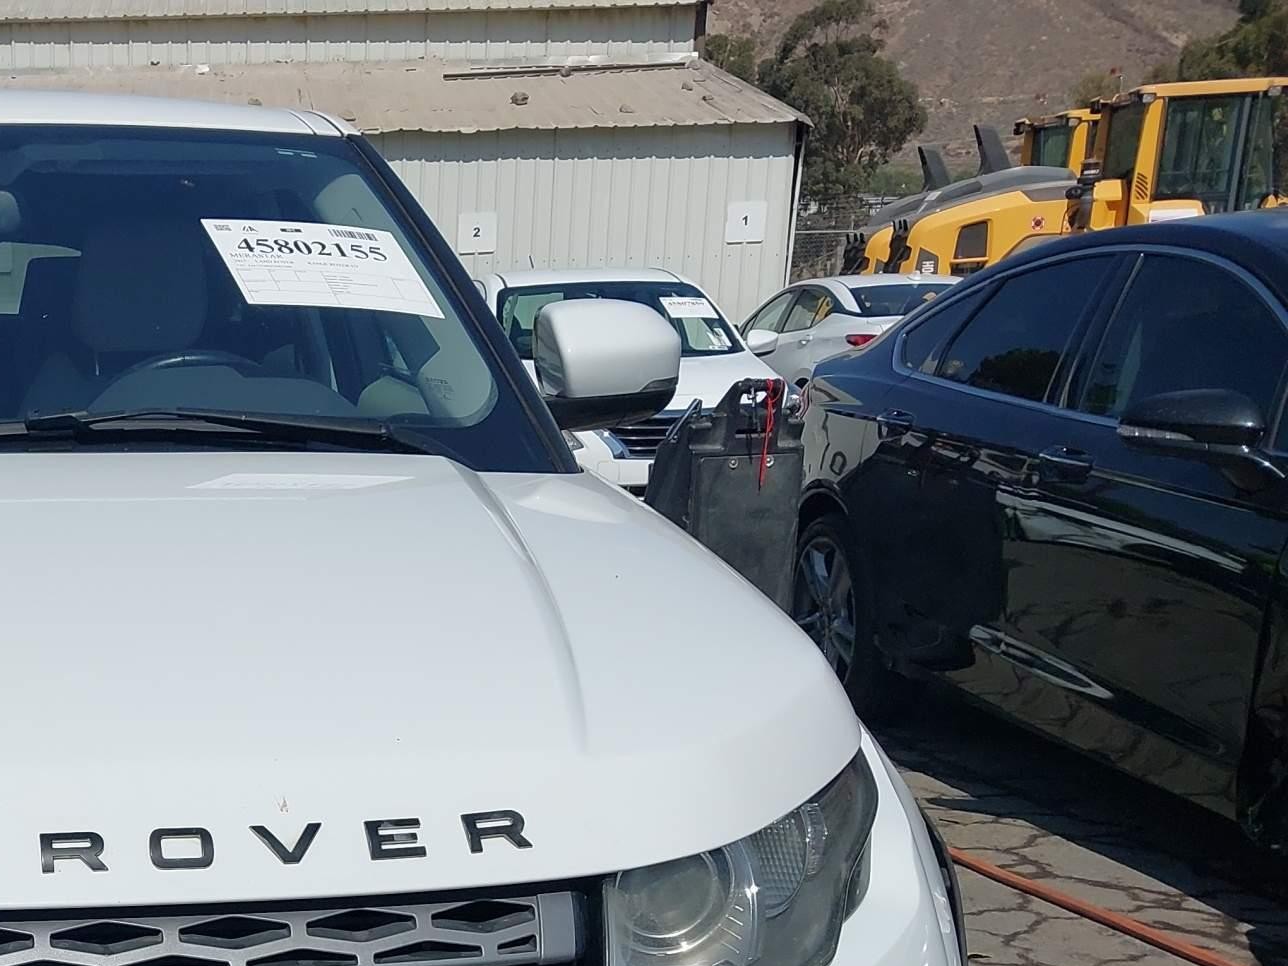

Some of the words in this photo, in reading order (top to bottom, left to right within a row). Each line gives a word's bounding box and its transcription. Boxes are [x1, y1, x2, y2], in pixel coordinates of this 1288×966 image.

[742, 215, 748, 226] 1
[472, 227, 481, 238] 2
[237, 238, 388, 261] 45802155
[39, 809, 533, 874] ROVER
